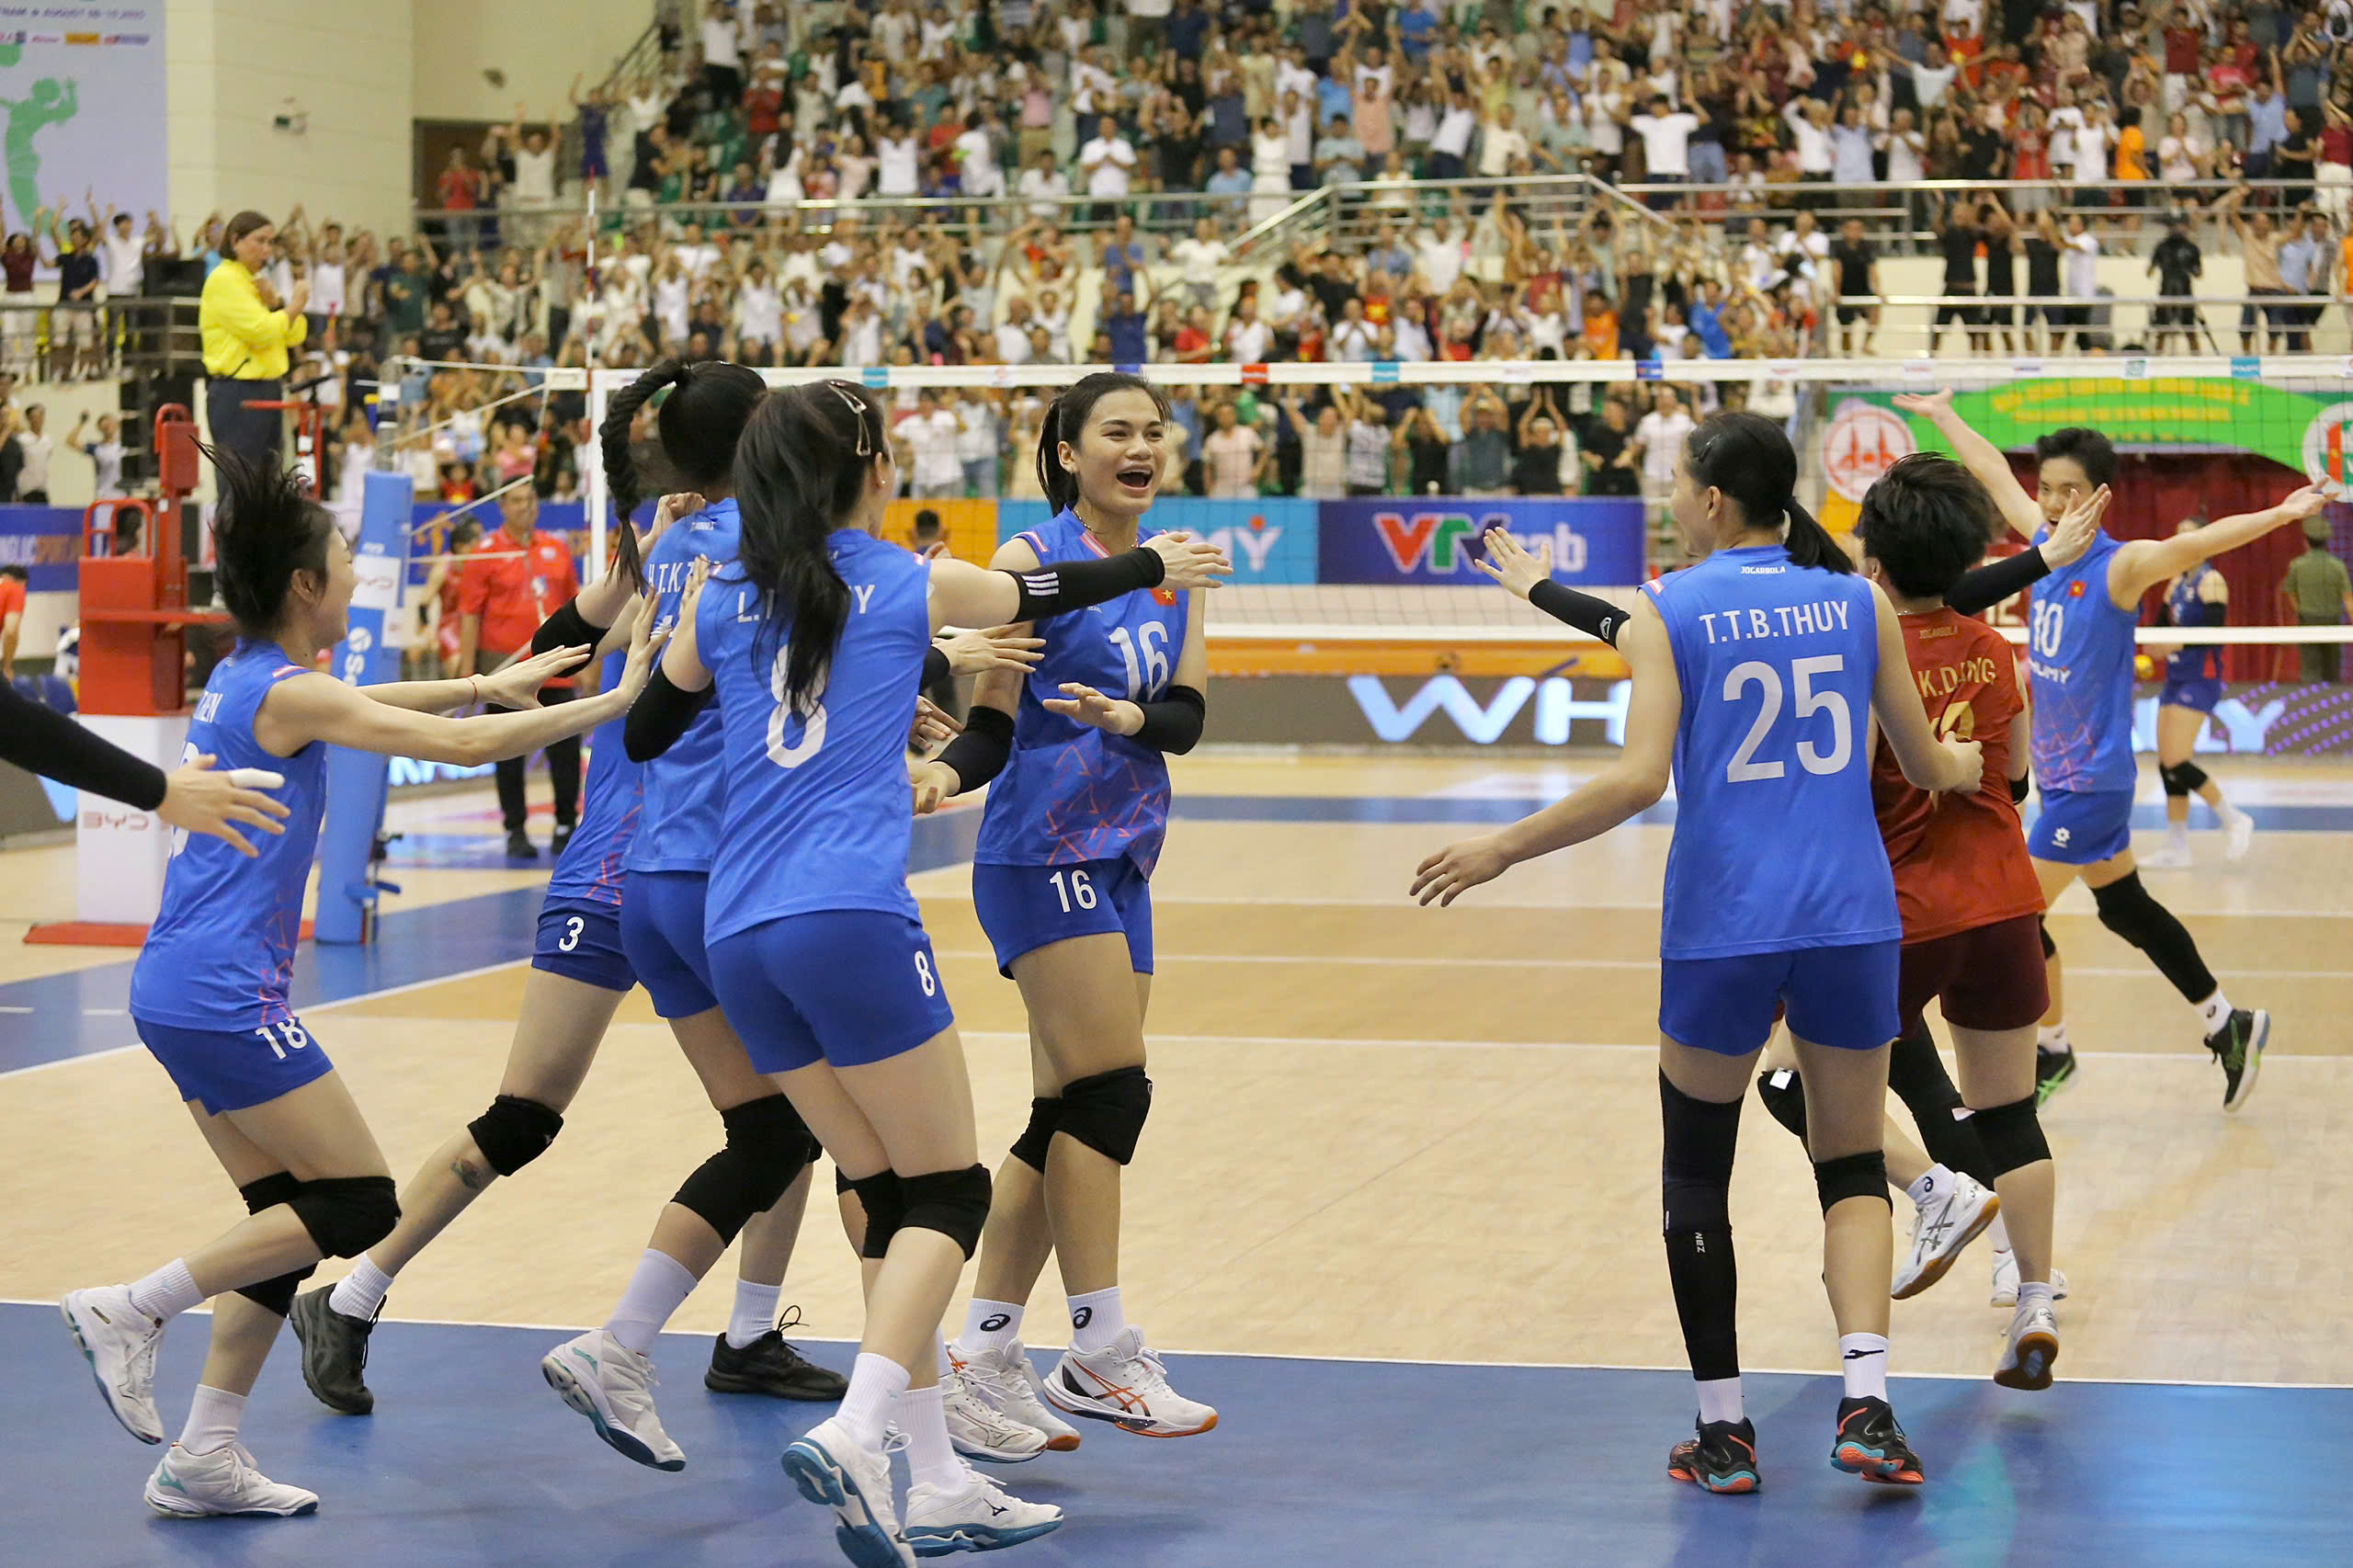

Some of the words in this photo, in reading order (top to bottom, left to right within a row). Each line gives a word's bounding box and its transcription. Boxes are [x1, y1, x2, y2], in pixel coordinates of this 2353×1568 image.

[1699, 600, 1848, 644] T.T.B.THUY
[2033, 598, 2064, 659] 10
[1108, 620, 1169, 703] 16
[1722, 653, 1853, 783] 25
[1049, 869, 1097, 914] 16
[558, 915, 585, 952] 3
[914, 949, 936, 997] 8
[255, 1017, 308, 1060] 18
